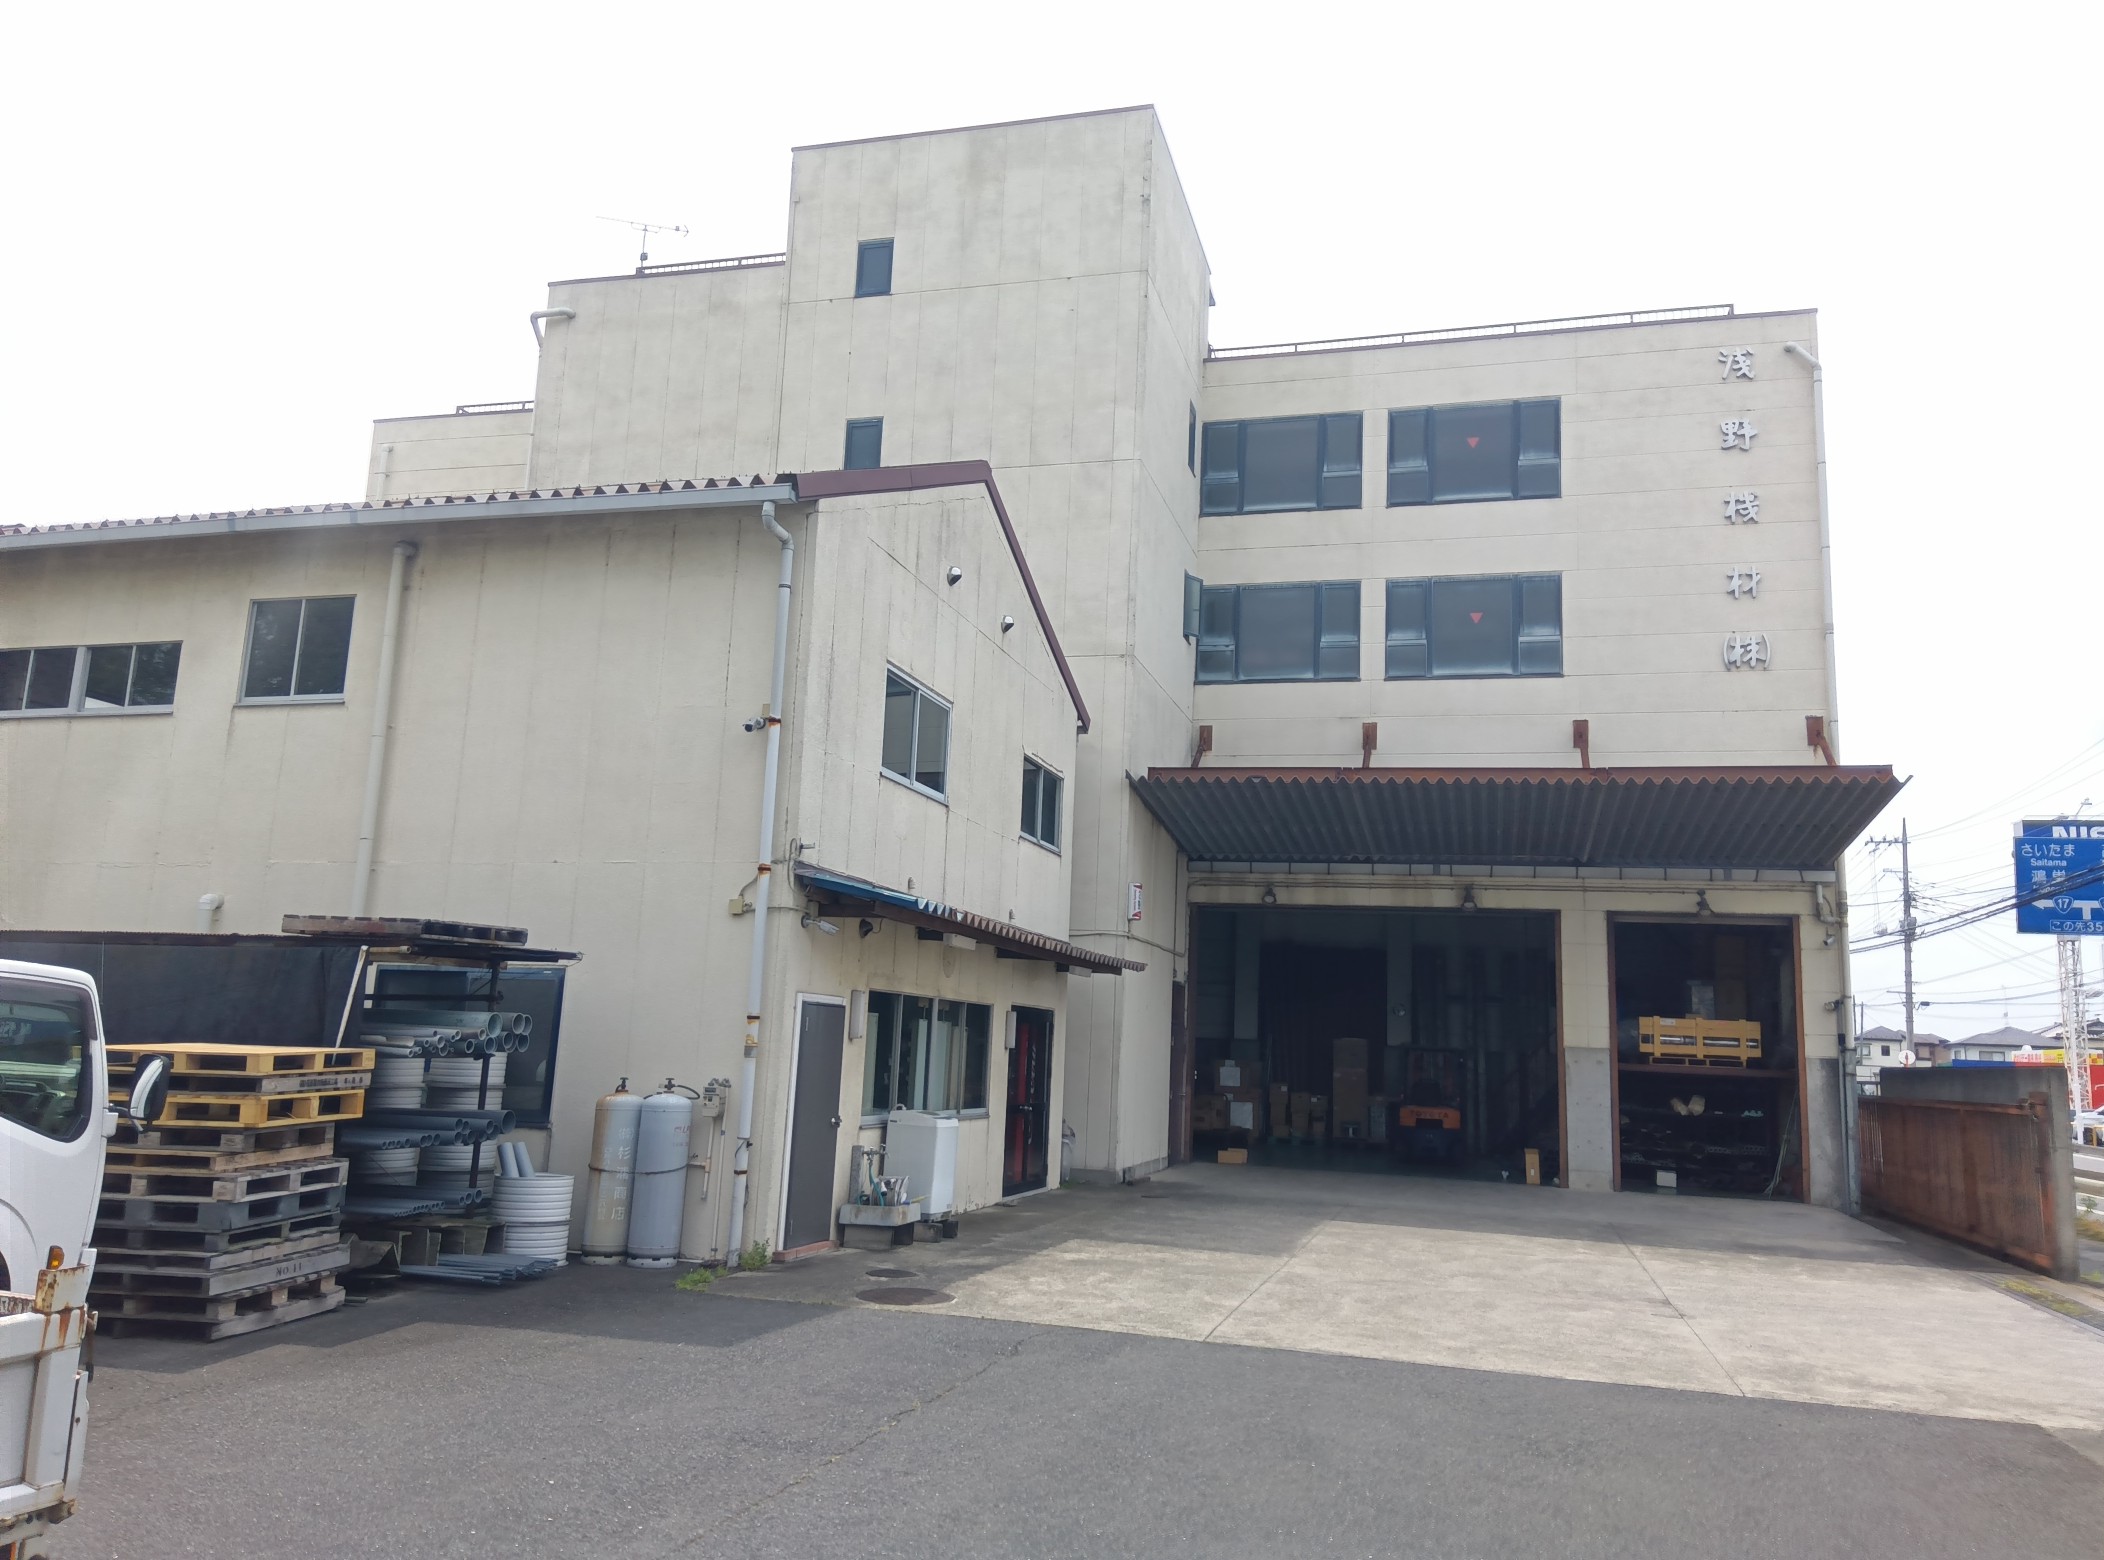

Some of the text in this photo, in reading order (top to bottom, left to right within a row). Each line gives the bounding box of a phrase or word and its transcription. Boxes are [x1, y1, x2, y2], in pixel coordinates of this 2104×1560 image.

[2021, 843, 2075, 857] さいたま
[2030, 858, 2067, 867] Saitama
[2058, 898, 2069, 908] 17
